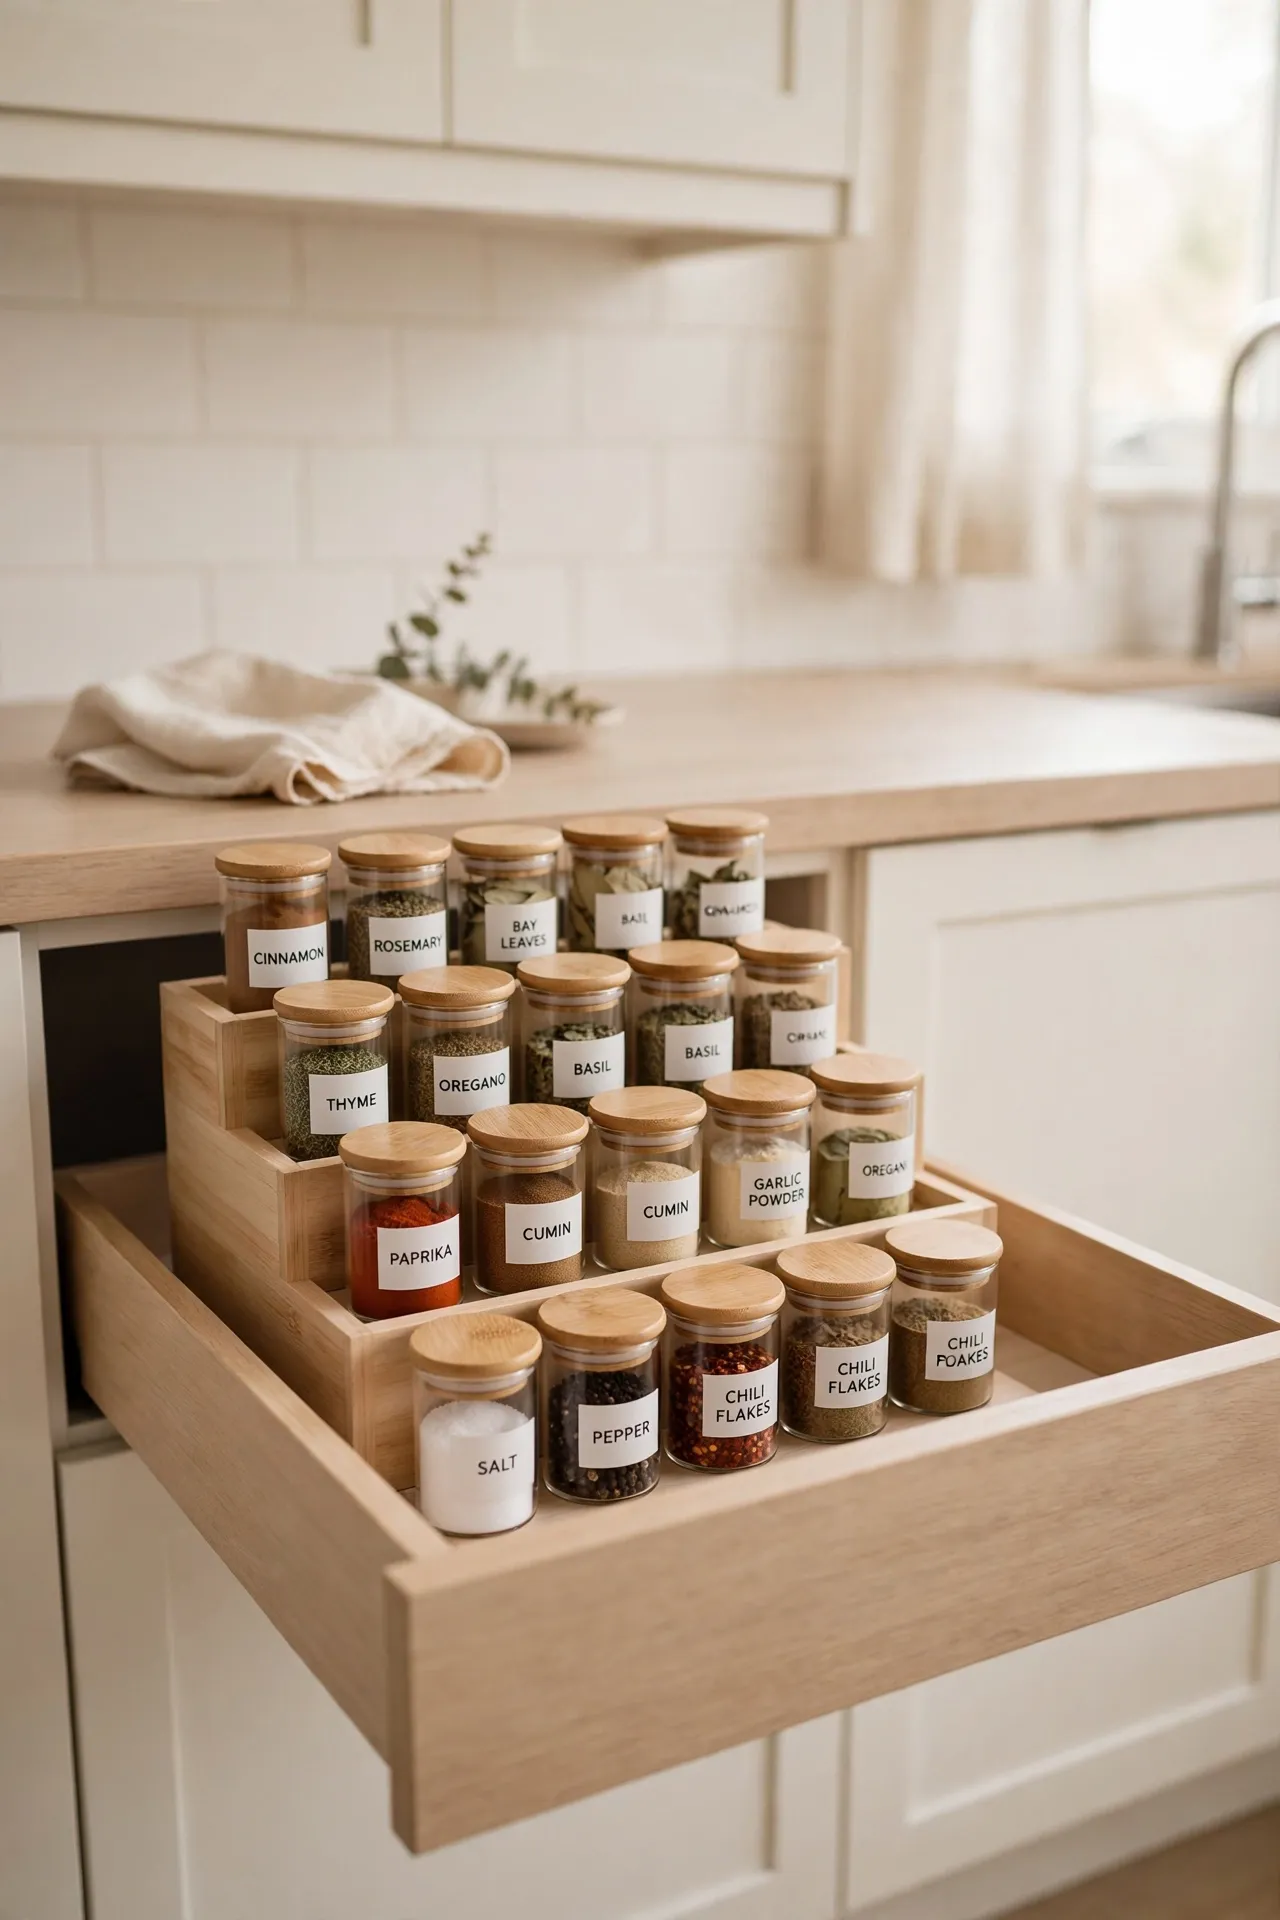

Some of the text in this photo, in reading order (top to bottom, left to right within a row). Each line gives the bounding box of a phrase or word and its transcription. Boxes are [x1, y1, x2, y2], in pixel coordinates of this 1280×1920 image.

[513, 919, 538, 933] BAY
[374, 935, 443, 953] ROSEMARY
[501, 934, 547, 949] LEAVES
[254, 947, 324, 965] CINNAMON
[685, 1044, 721, 1059] BASIL
[574, 1060, 612, 1076] BASIL
[439, 1072, 506, 1092] OREGANO
[326, 1093, 377, 1111] THYME
[754, 1172, 802, 1190] GARLIC
[749, 1188, 805, 1207] POWDER
[643, 1200, 689, 1219] CUMIN
[523, 1221, 571, 1241] CUMIN
[390, 1244, 453, 1265] PAPRIKA
[948, 1332, 984, 1350] CHILI
[838, 1357, 876, 1376] CHILI
[828, 1373, 881, 1394] FLAKES
[725, 1384, 765, 1404] CHILI
[716, 1400, 771, 1423] FLAKES
[593, 1420, 650, 1444] PEPPER
[478, 1454, 517, 1475] SALT
